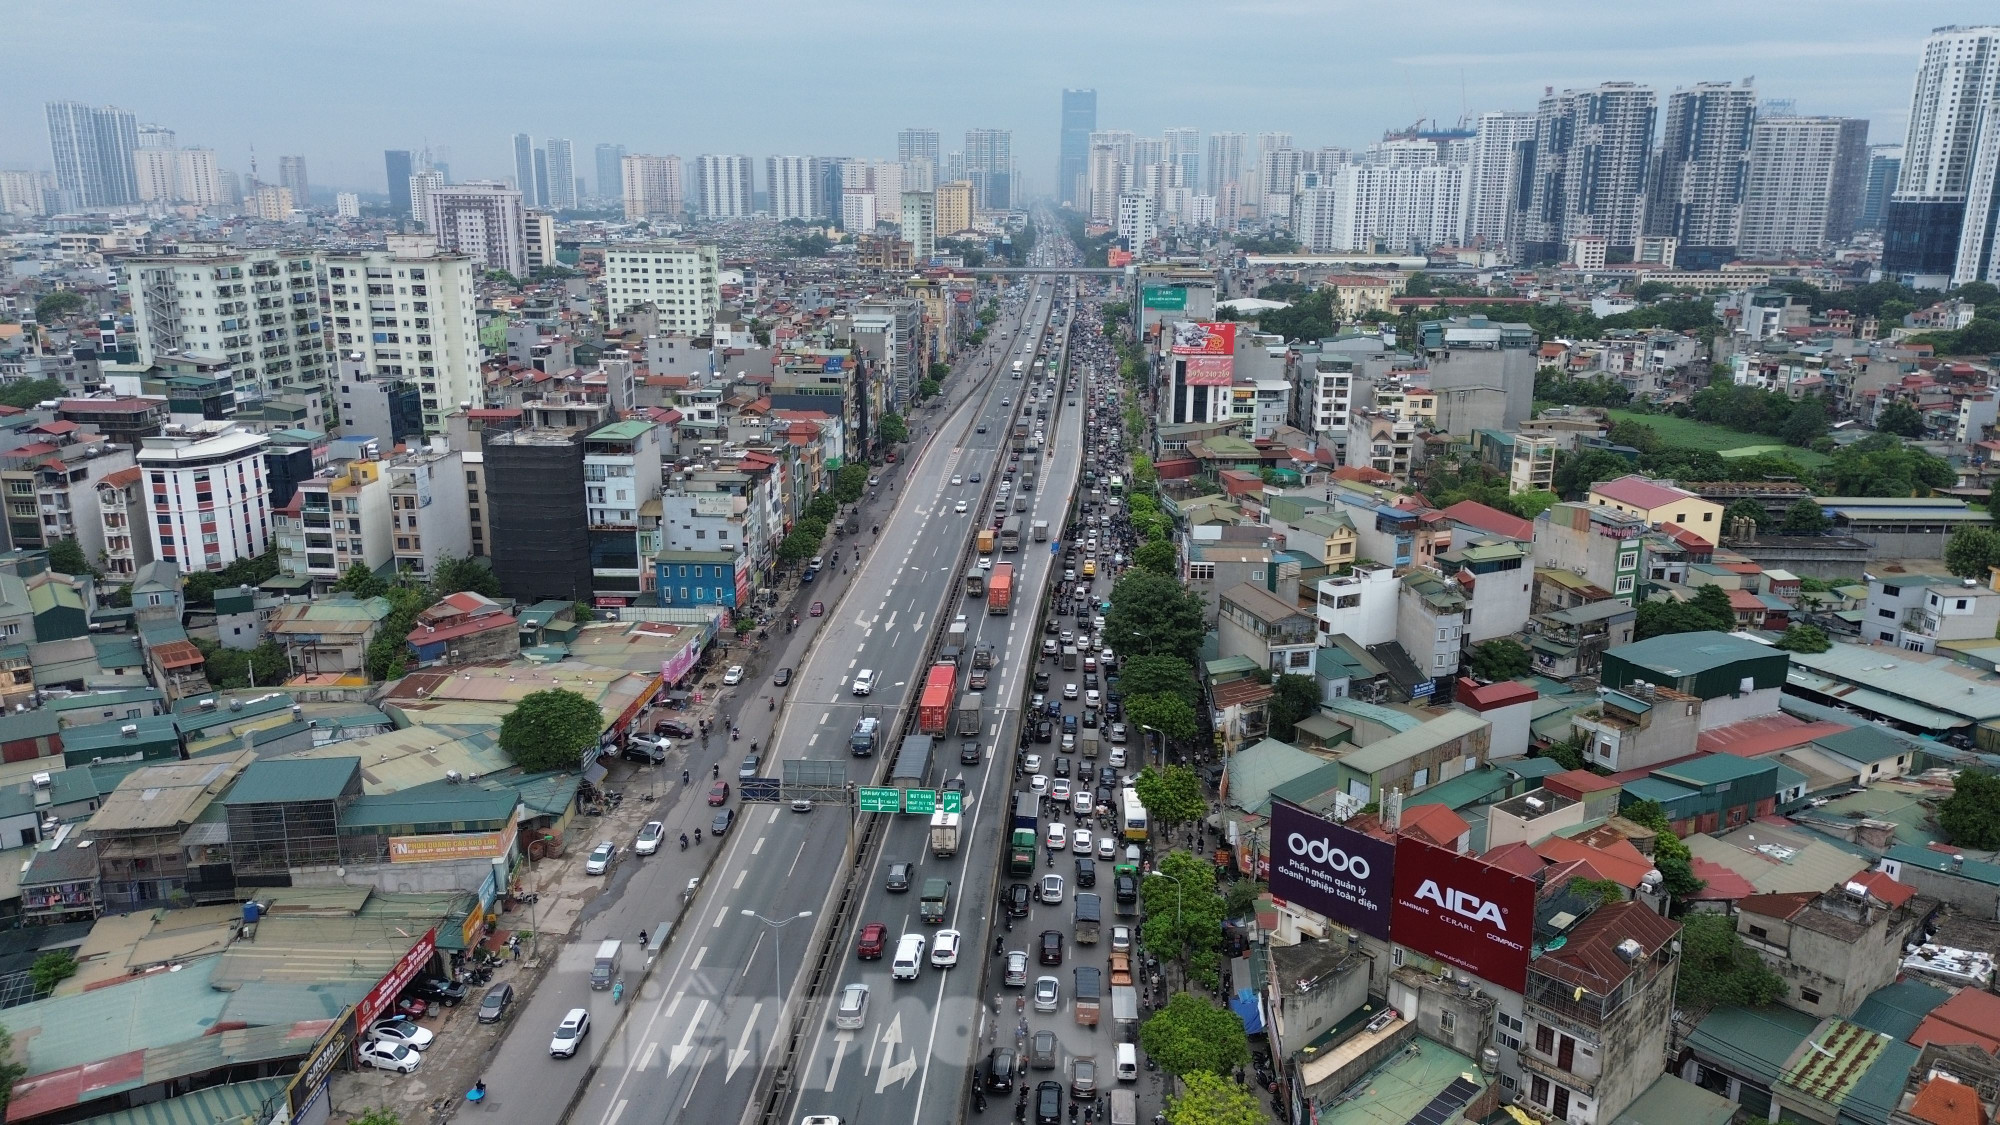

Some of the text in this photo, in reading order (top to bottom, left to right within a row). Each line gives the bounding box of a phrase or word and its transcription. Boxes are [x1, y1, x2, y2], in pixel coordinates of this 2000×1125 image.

[1288, 832, 1370, 880] odoo
[1278, 865, 1378, 911] doanh nghiệp toàn diện
[1334, 876, 1357, 892] quản
[1358, 885, 1367, 896] lý
[1398, 899, 1430, 916] LAMINATE
[1439, 915, 1476, 933] CERARL
[1486, 932, 1525, 952] COMPACT
